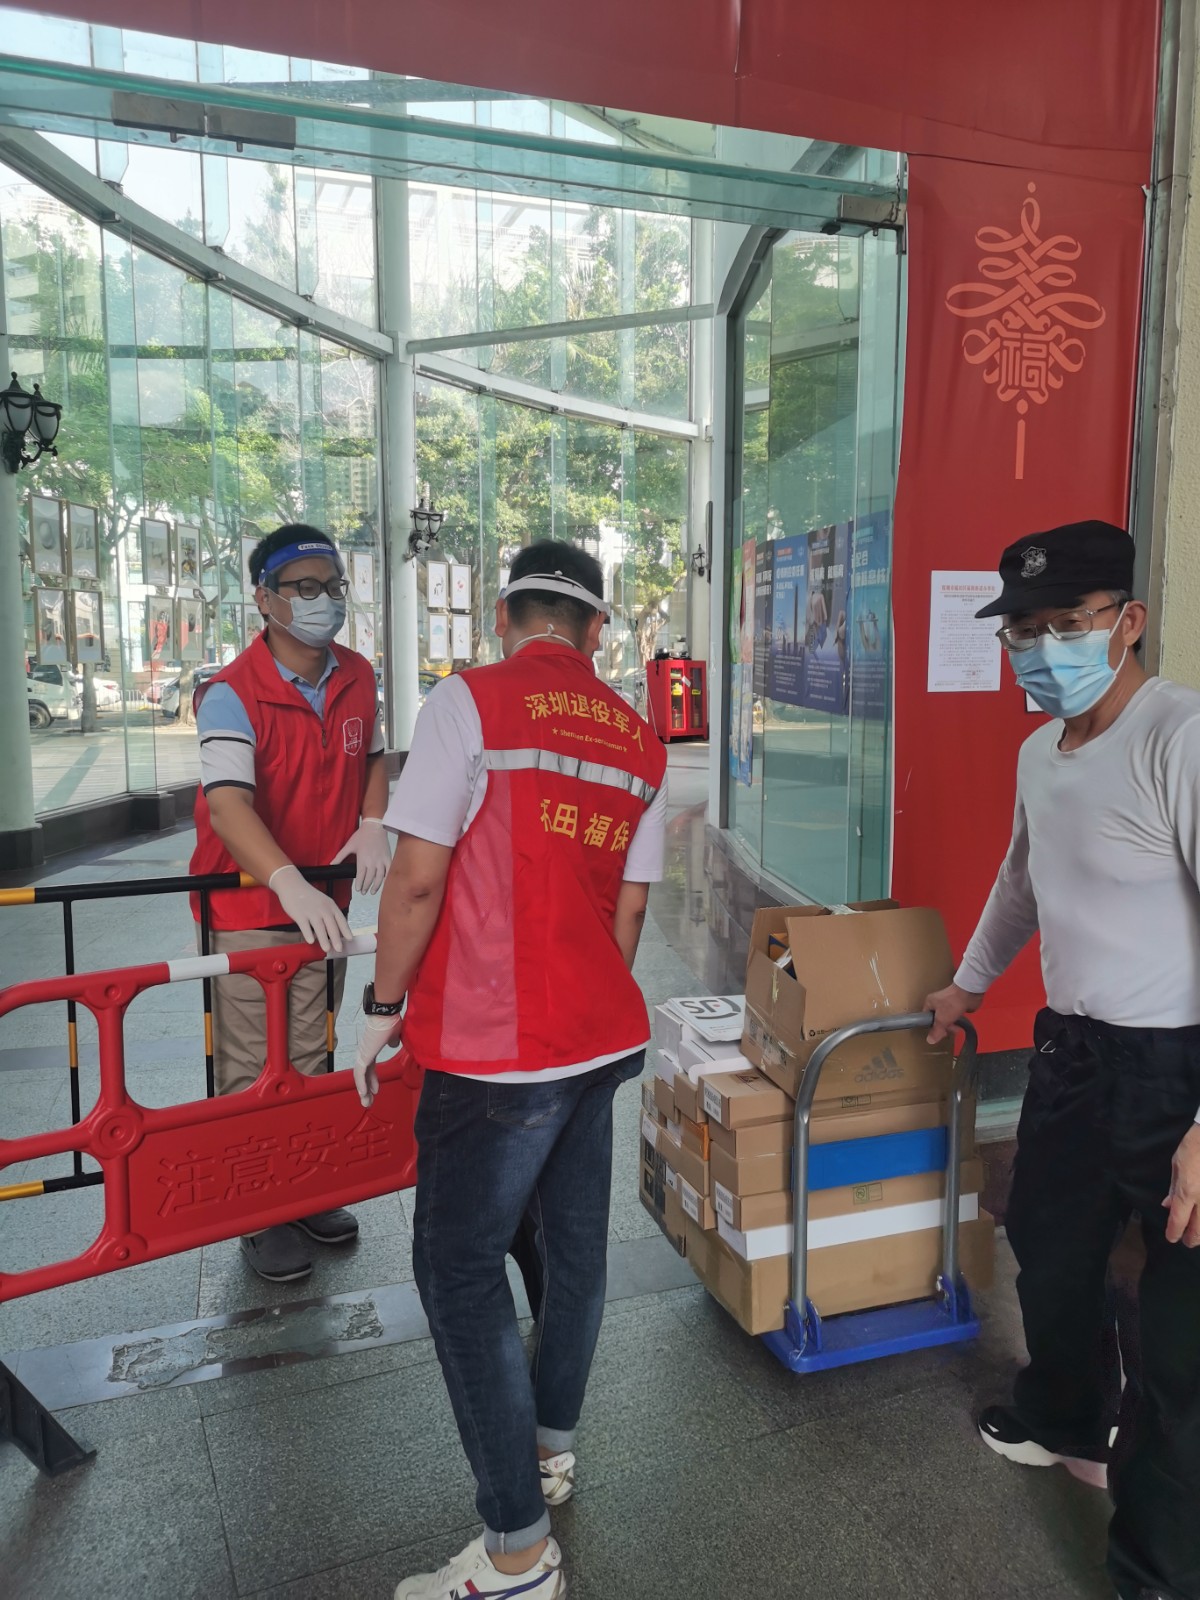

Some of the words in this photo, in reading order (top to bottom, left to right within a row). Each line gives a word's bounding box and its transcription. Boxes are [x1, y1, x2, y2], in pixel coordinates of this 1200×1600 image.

[524, 691, 644, 752] 深圳退役军人
[854, 1067, 905, 1083] adidas
[157, 1109, 394, 1218] 注意安全
